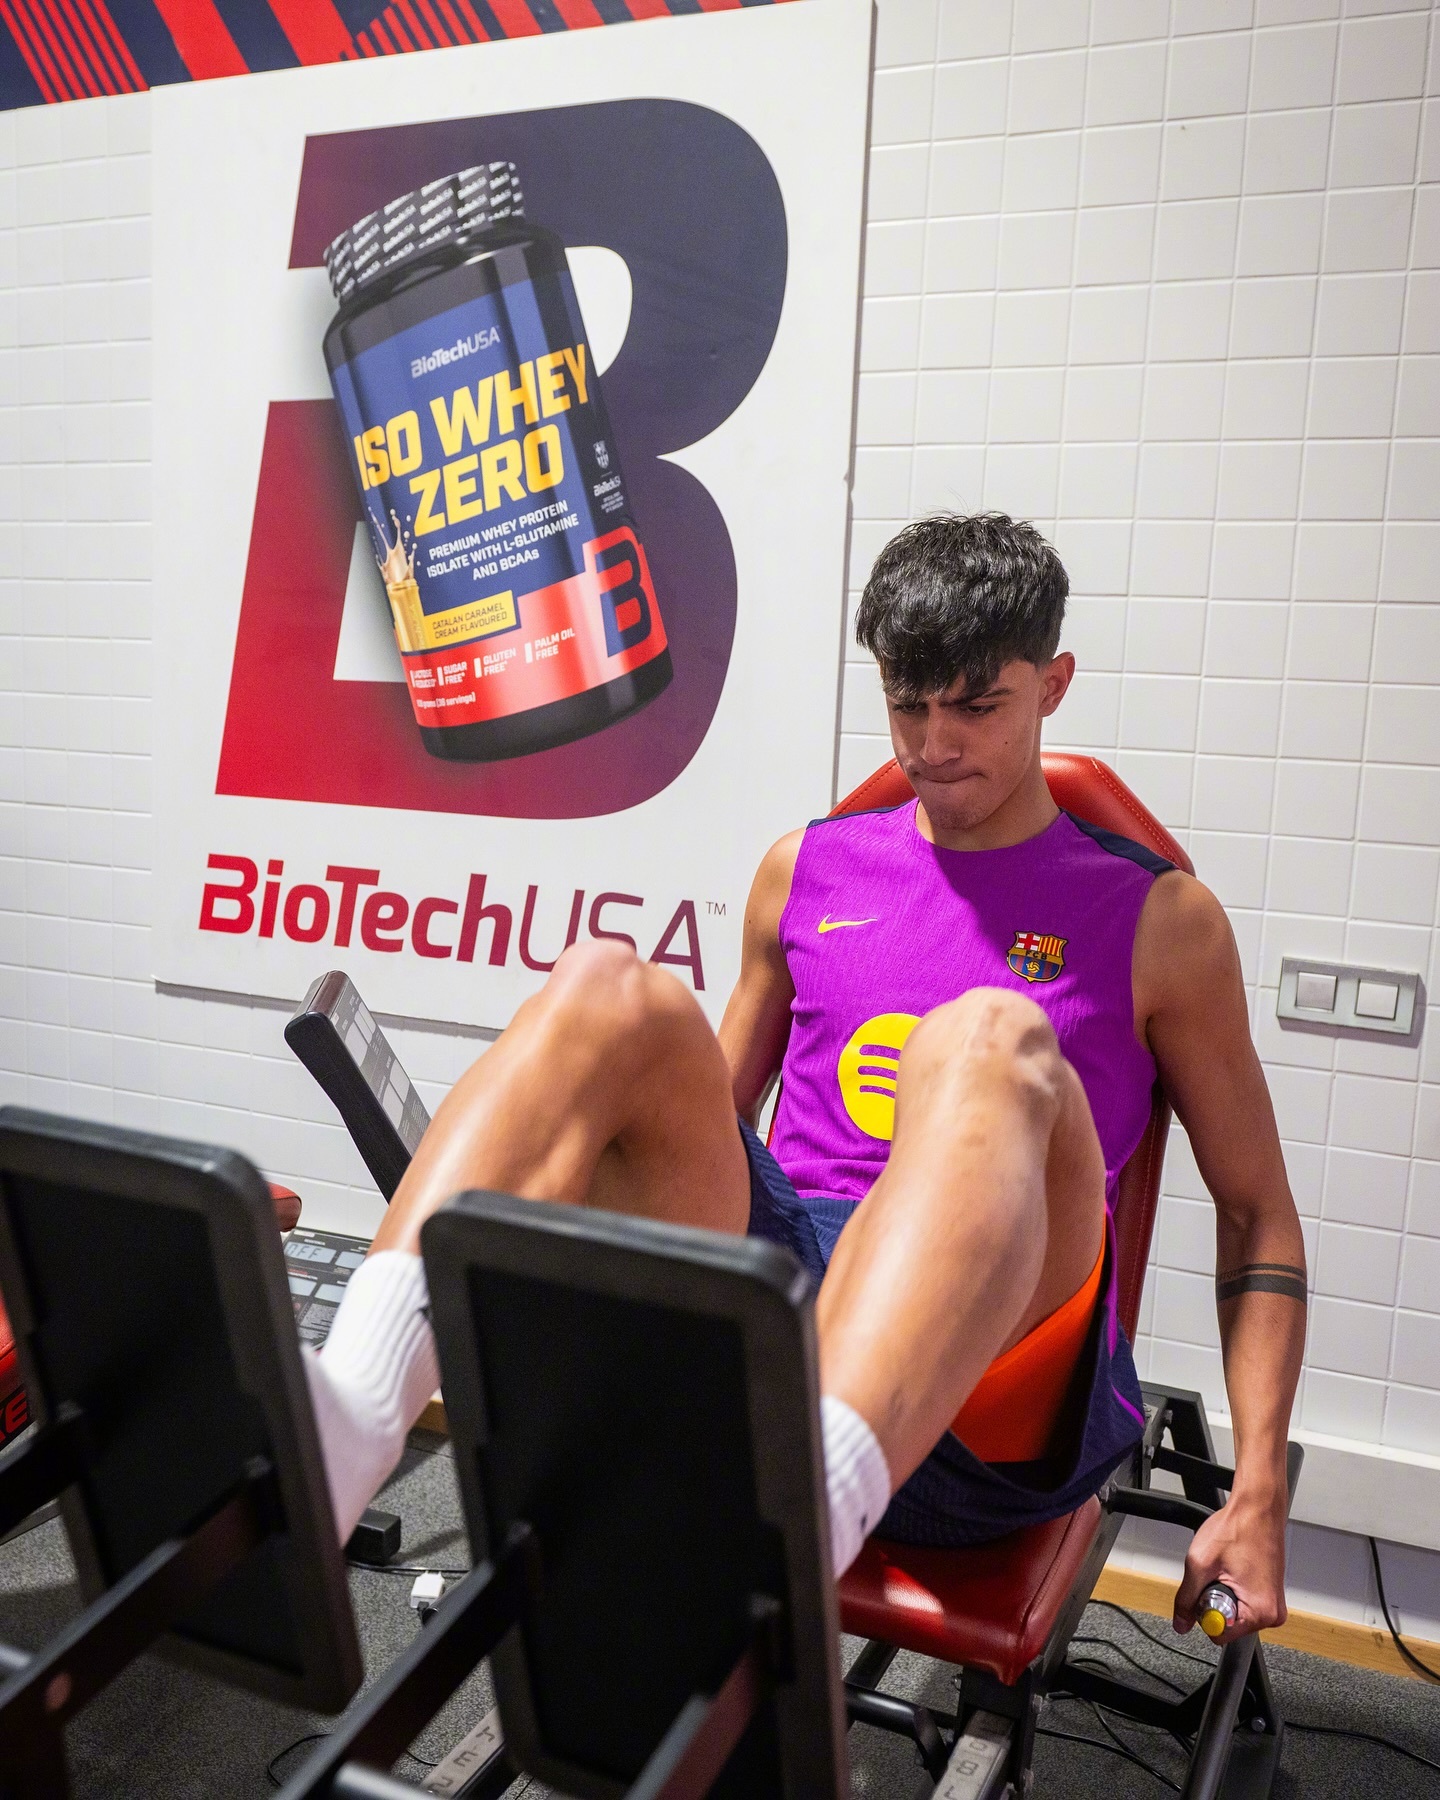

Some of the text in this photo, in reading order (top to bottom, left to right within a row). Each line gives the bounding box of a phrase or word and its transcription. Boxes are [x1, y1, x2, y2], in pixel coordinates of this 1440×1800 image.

[411, 327, 500, 379] BioTechUSA
[354, 344, 588, 491] ISO WHEY
[409, 424, 565, 537] ZERO
[429, 499, 568, 560] PREMIUM WHEY PROTEIN
[427, 513, 579, 578] ISOLATE WITH L-GLUTAMINE
[473, 549, 540, 580] AND BCAAs
[432, 603, 505, 630] CATALAN CARAMEL
[435, 611, 507, 639] CREAM FLAVOURED
[534, 628, 576, 649] PALM OIL
[535, 644, 559, 660] FREE
[443, 661, 467, 675] SUGAR
[483, 647, 517, 665] GLUTEN
[198, 853, 705, 991] BioTechUSA
